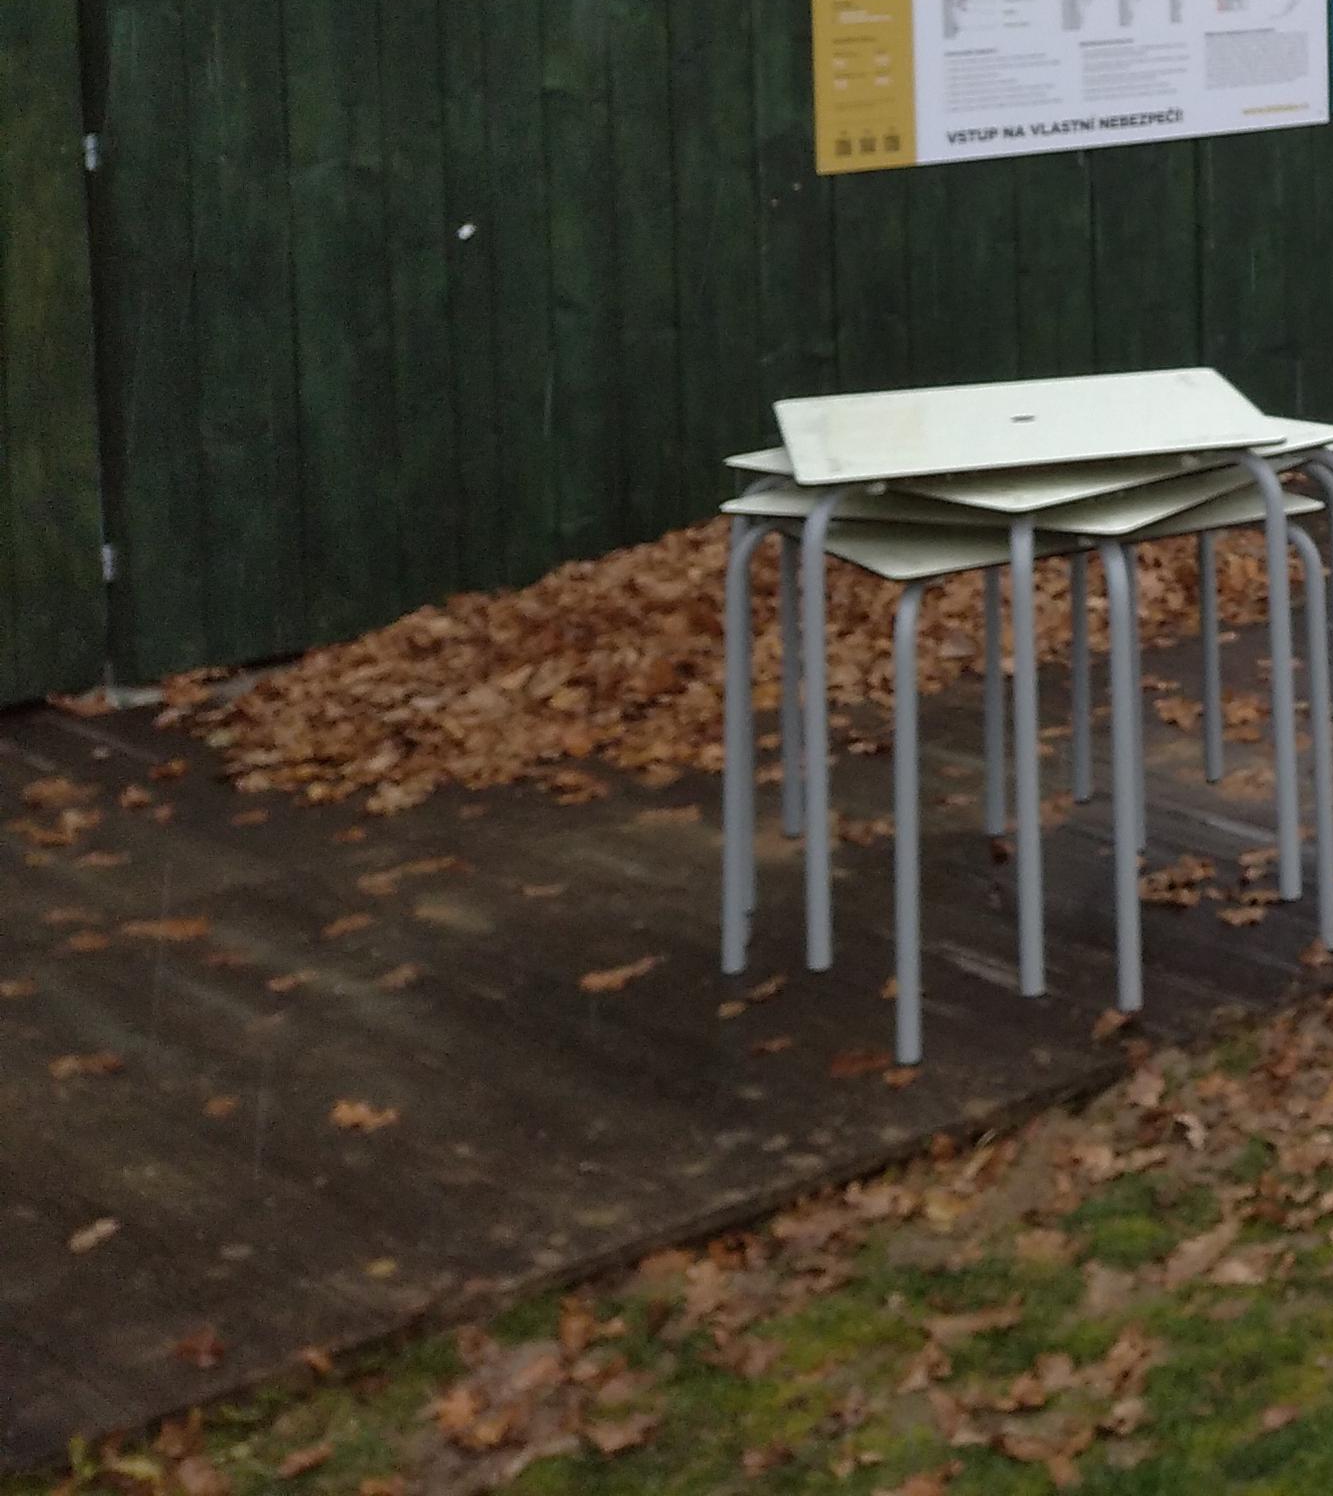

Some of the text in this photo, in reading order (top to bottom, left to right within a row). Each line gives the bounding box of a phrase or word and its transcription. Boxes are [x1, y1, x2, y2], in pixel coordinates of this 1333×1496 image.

[947, 128, 998, 145] VSTUP
[1003, 125, 1025, 139] NA
[1030, 118, 1095, 137] VLASTNÍ
